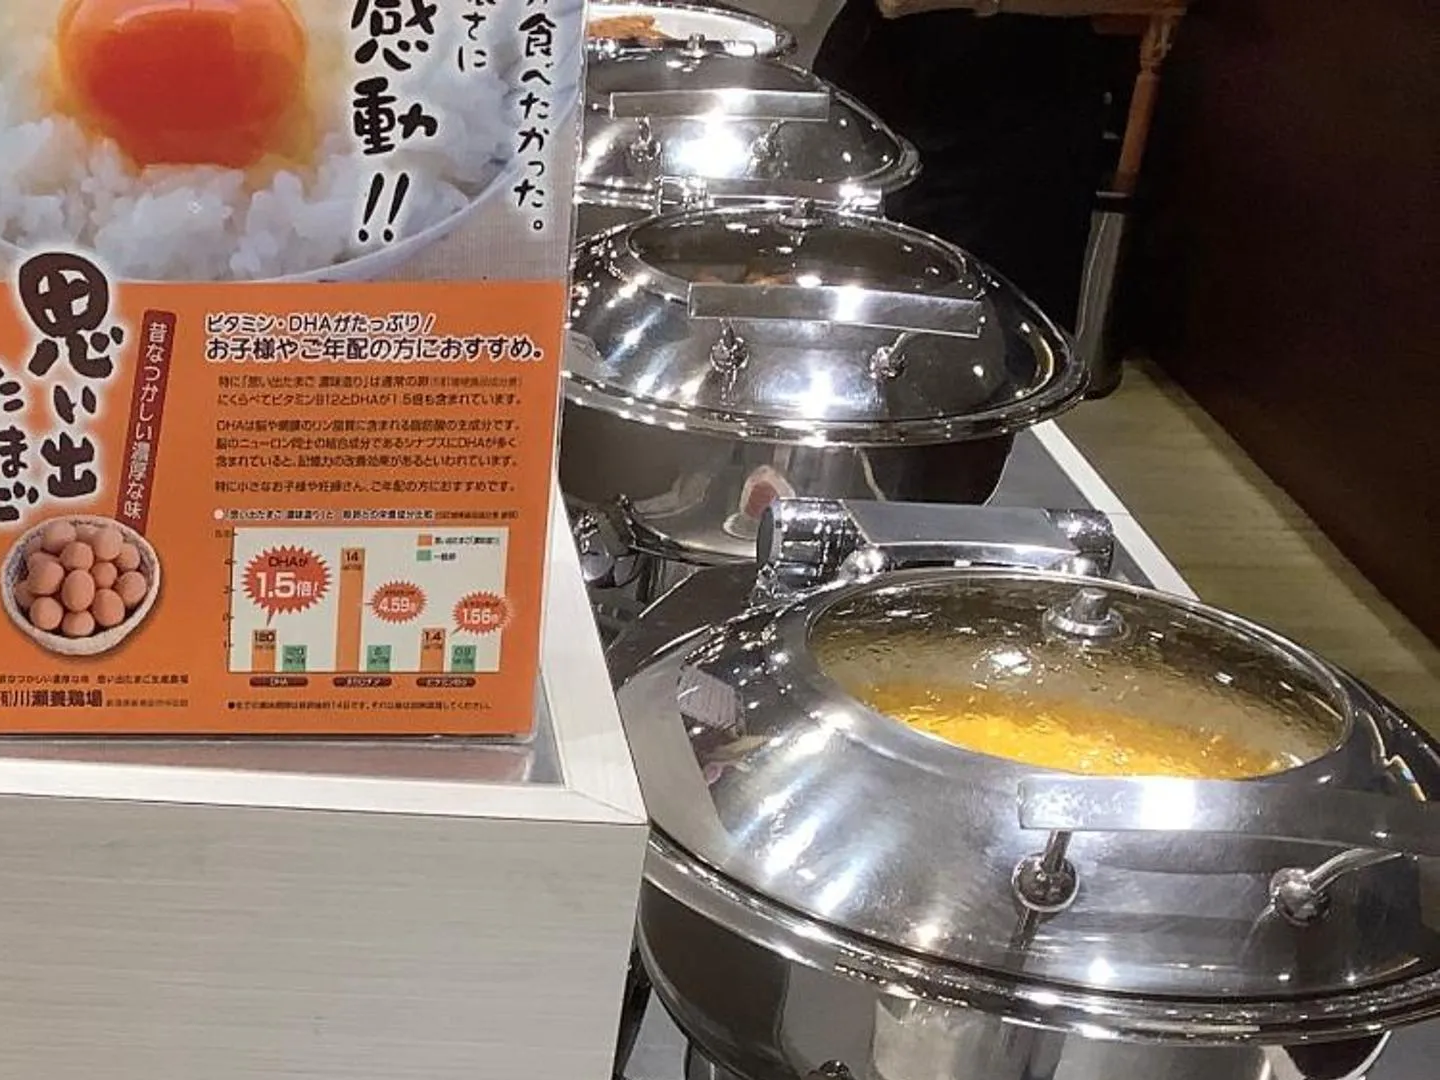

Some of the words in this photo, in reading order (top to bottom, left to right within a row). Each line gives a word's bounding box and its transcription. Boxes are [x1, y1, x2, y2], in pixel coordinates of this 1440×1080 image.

[458, 0, 496, 72] さに
[513, 0, 556, 231] 食べたかった。
[19, 252, 124, 497] 思い出
[123, 321, 168, 520] 昔なつかしい濃厚な味
[206, 337, 544, 362] お子様やご年配の方におすすめ。
